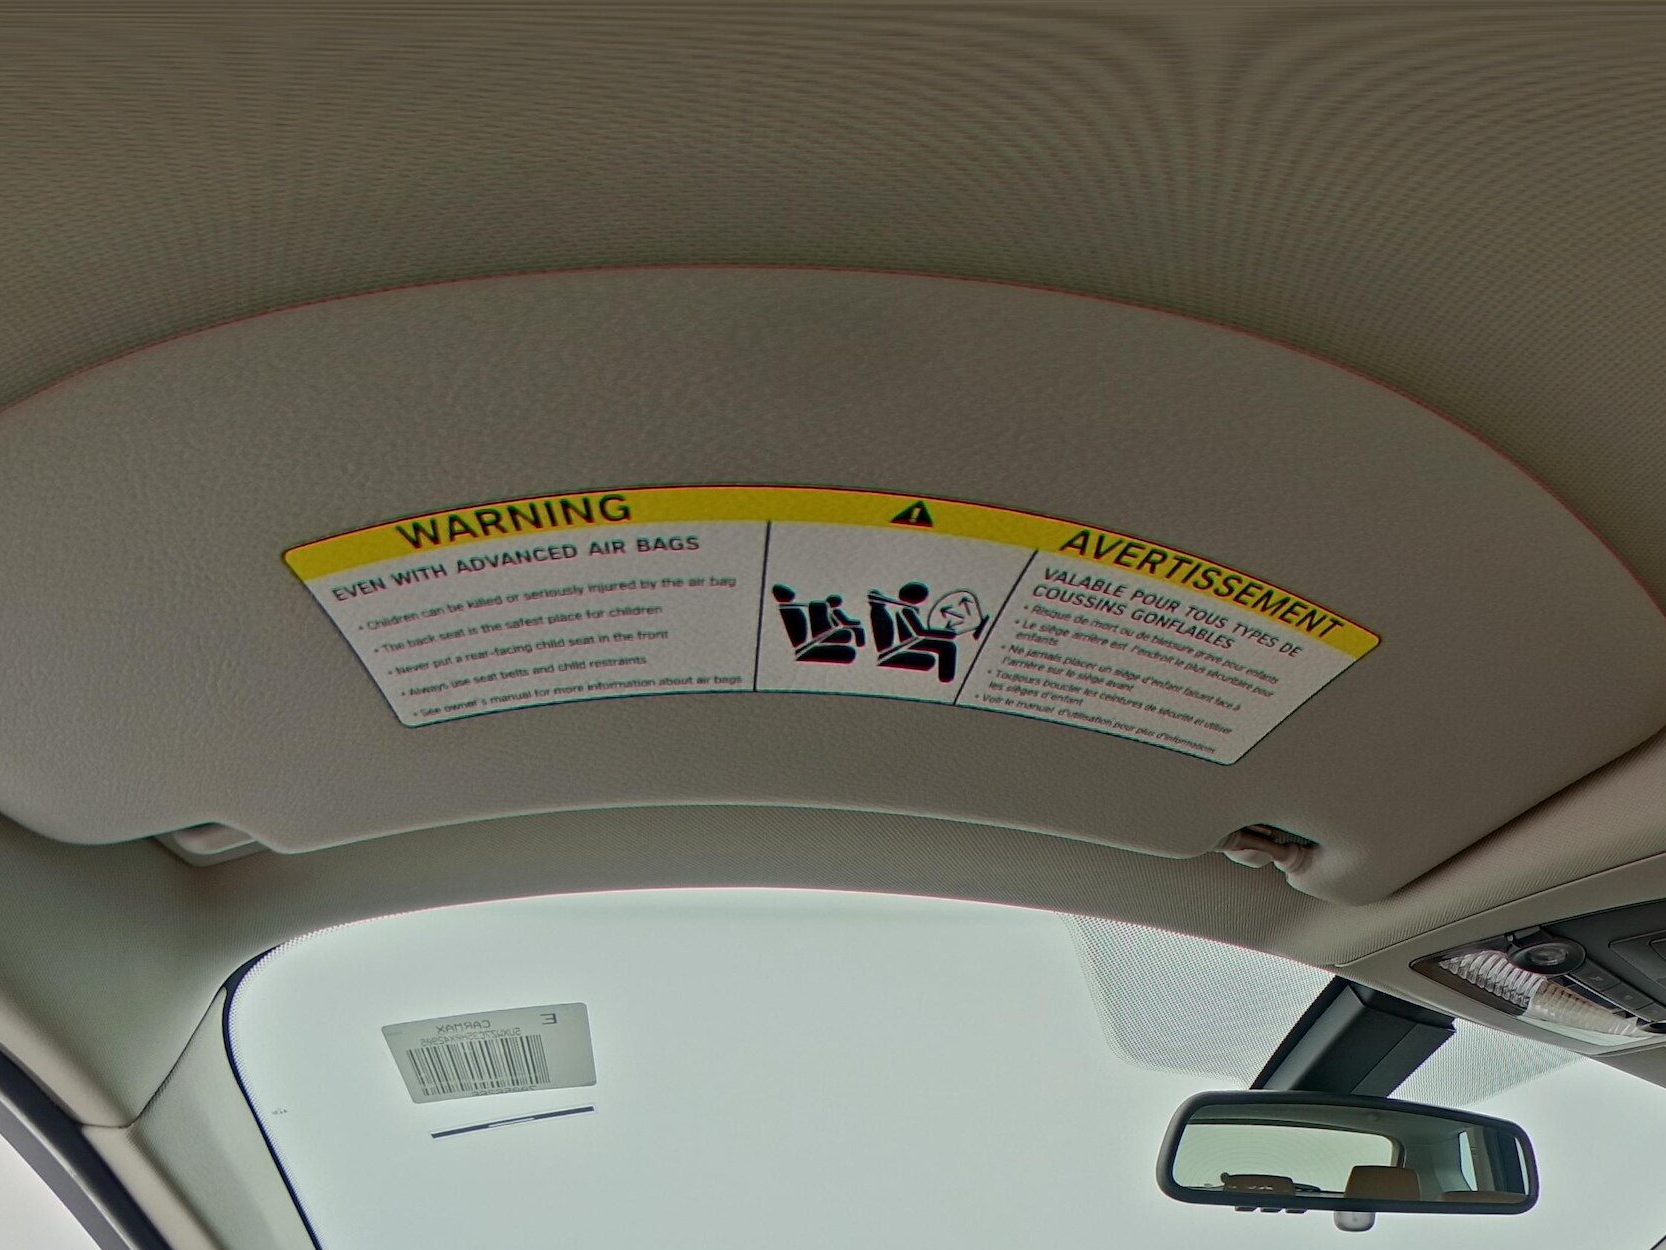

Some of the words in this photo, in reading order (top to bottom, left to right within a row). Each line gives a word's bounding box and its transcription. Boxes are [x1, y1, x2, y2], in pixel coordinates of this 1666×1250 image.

[395, 494, 631, 550] WARNING
[332, 577, 386, 601] EVEN
[391, 564, 448, 587] WITH
[456, 543, 577, 575] ADVANCED
[589, 540, 625, 556] AIR
[637, 536, 699, 553] BAGS
[1060, 530, 1344, 638] AVERTISSEMENT
[367, 612, 418, 630] Children
[422, 607, 445, 618] can
[447, 603, 464, 613] be
[468, 595, 503, 609] killed
[506, 593, 519, 603] or
[524, 584, 583, 600] seriously
[588, 580, 636, 593] injured
[640, 579, 657, 590] by
[661, 577, 684, 587] the
[688, 577, 705, 586] air
[711, 577, 736, 588] bag
[1022, 619, 1036, 629] Le
[1033, 585, 1127, 616] COUSSINS
[1131, 608, 1235, 650] GONFLABLES
[1044, 568, 1128, 599] VALABLE
[1130, 590, 1181, 613] POUR
[1186, 606, 1228, 629] TOUS
[1234, 623, 1279, 648] TYPES
[1279, 640, 1303, 658] DE
[382, 643, 404, 652] The
[407, 635, 436, 648] back
[439, 628, 466, 640] seat
[468, 627, 479, 635] is
[481, 622, 502, 633] the
[505, 615, 545, 630] safest
[548, 613, 582, 625] place
[586, 610, 604, 619] for
[609, 606, 663, 618] children
[1008, 644, 1024, 654] Ne
[1074, 614, 1088, 625] de
[1090, 620, 1119, 633] mort
[1120, 627, 1134, 637] ou
[1136, 631, 1151, 641] de
[395, 663, 430, 675] Never
[433, 658, 451, 669] put
[465, 643, 533, 661] rear-facing
[536, 639, 565, 650] child
[569, 635, 595, 646] seat
[598, 635, 609, 643] in
[613, 632, 633, 641] the
[637, 630, 668, 640] front
[409, 684, 450, 697] Always
[451, 679, 471, 689] use
[473, 673, 498, 685] seat
[500, 668, 529, 680] belts
[533, 665, 554, 675] and
[558, 661, 585, 672] child
[590, 656, 647, 668] restraints
[420, 707, 441, 717] See
[490, 691, 531, 704] manual
[535, 688, 550, 697] for
[554, 685, 583, 694] more
[587, 678, 656, 691] information
[658, 676, 693, 686] about
[696, 676, 710, 684] air
[714, 675, 742, 685] bags
